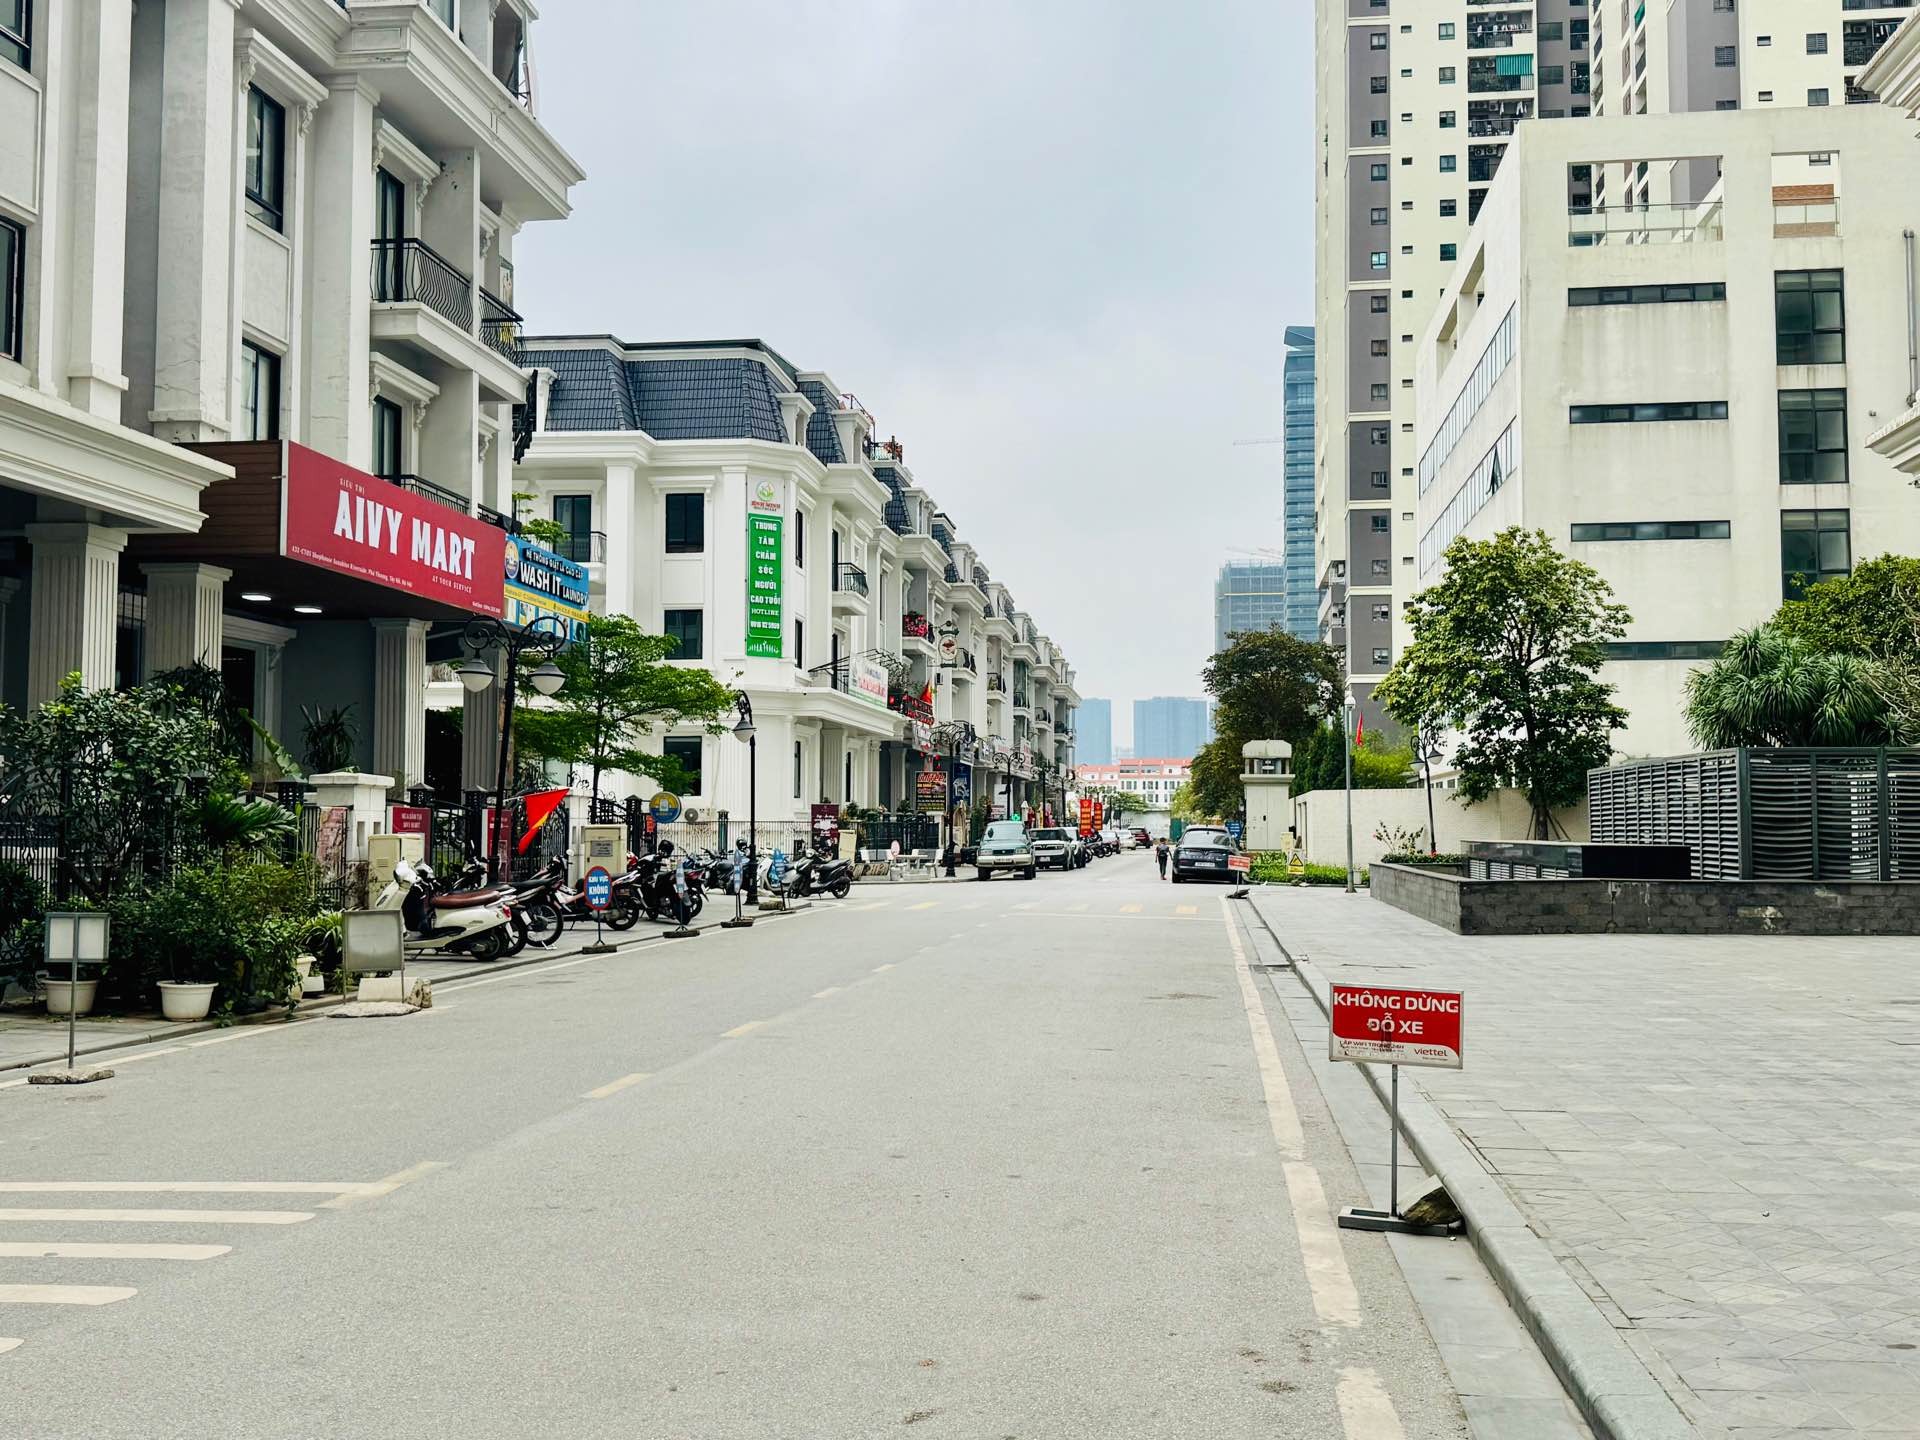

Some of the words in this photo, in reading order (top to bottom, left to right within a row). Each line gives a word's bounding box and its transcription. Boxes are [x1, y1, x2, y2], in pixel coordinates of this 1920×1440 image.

[755, 521, 777, 531] TRUNG
[333, 489, 403, 556] AIVY
[411, 517, 476, 580] MART
[757, 564, 774, 575] SÓC
[520, 561, 550, 593] WASH
[552, 574, 562, 596] IT
[562, 586, 589, 606] LAUNDRY
[750, 595, 764, 604] CAO
[751, 608, 779, 616] HOTLINE
[588, 884, 609, 895] KHÔNG
[1333, 990, 1401, 1010] KHÔNG
[1405, 993, 1459, 1013] DỪNG
[1366, 1012, 1395, 1033] ĐỖ
[1398, 1020, 1424, 1035] XE
[1414, 1048, 1448, 1057] viettel
